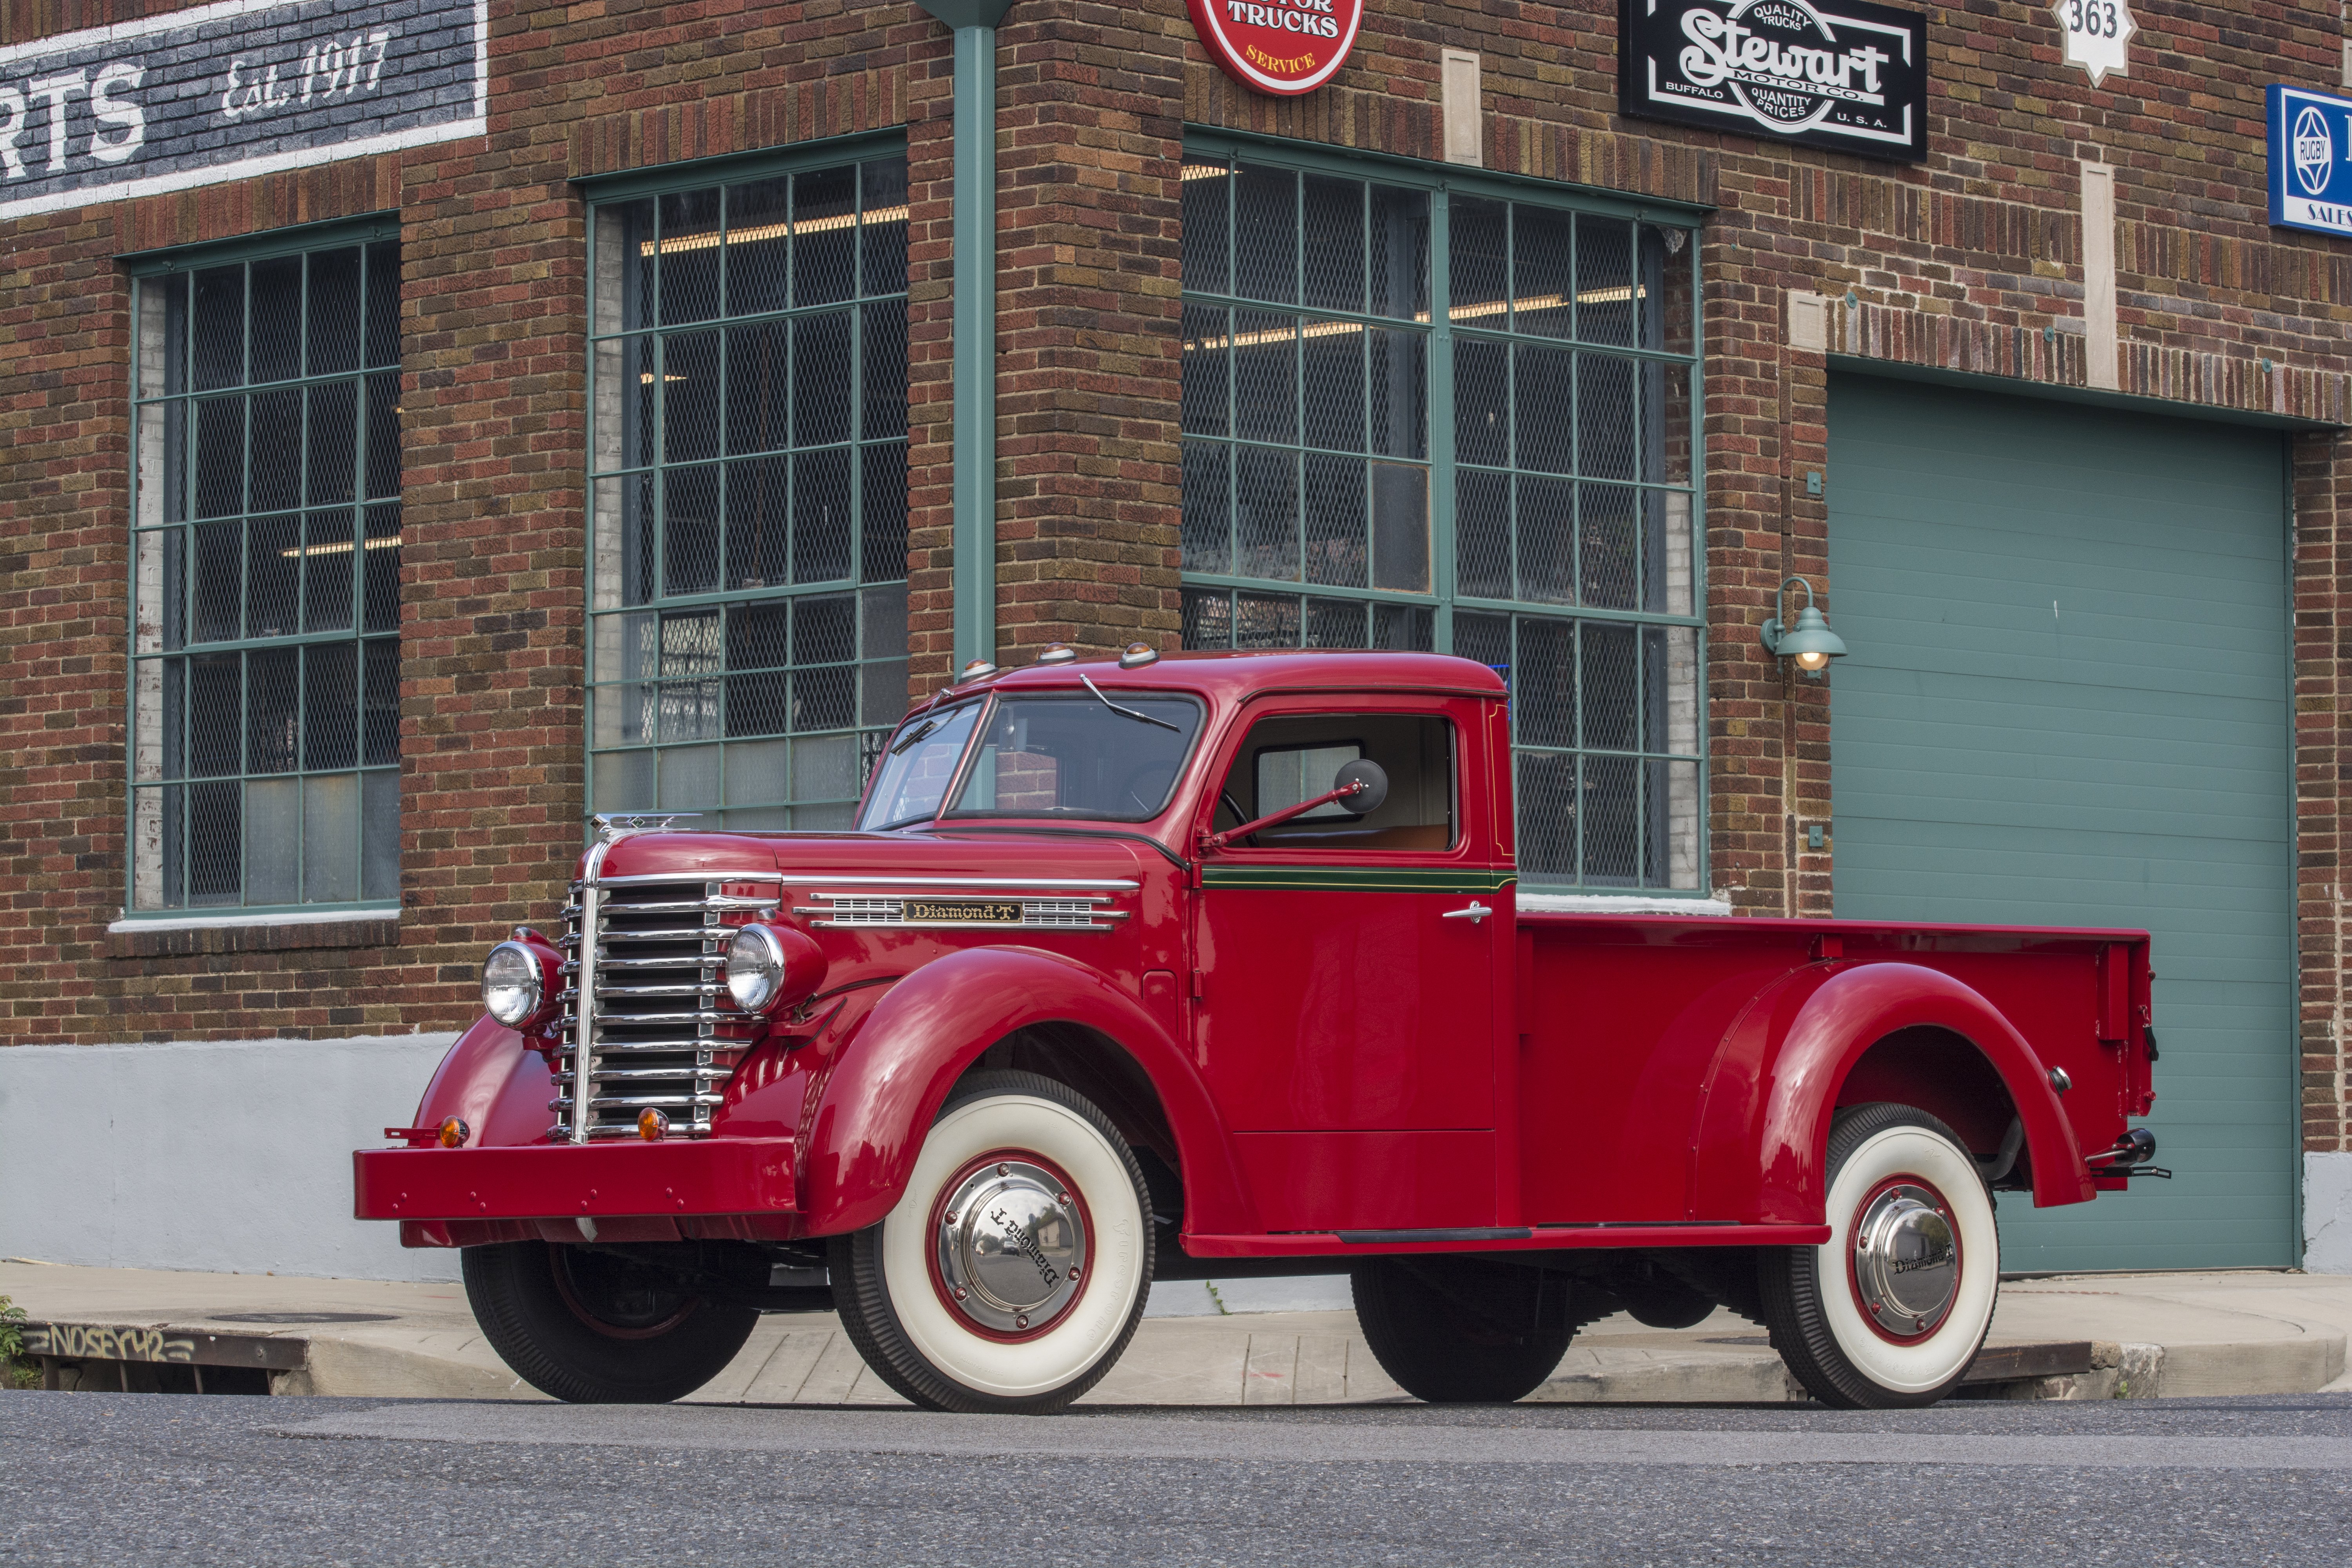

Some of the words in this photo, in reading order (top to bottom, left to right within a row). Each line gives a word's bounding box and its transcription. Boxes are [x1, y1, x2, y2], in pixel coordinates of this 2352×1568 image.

[1227, 0, 1339, 38] TRUCKS
[1753, 4, 1812, 27] QUALITY
[1762, 16, 1802, 31] TRUCKS
[2069, 0, 2117, 38] 363
[1246, 45, 1316, 73] SERVICE
[1679, 8, 1889, 93] Stewart
[301, 31, 388, 103] 1917
[1666, 82, 1724, 99] BUFFALO
[1733, 70, 1820, 93] MOTOR
[1826, 87, 1864, 101] CO.
[1751, 87, 1811, 105] QUANTITY
[1756, 98, 1806, 118] PRICES
[2300, 140, 2325, 161] RUGBY
[2307, 203, 2352, 227] SALES
[913, 903, 995, 920] Diamond
[996, 905, 1014, 920] T
[990, 1208, 1007, 1226] T
[1004, 1220, 1060, 1288] Diamond
[1893, 1248, 1944, 1275] Diamond
[1944, 1242, 1954, 1259] T
[1086, 1218, 1131, 1341] Firestone
